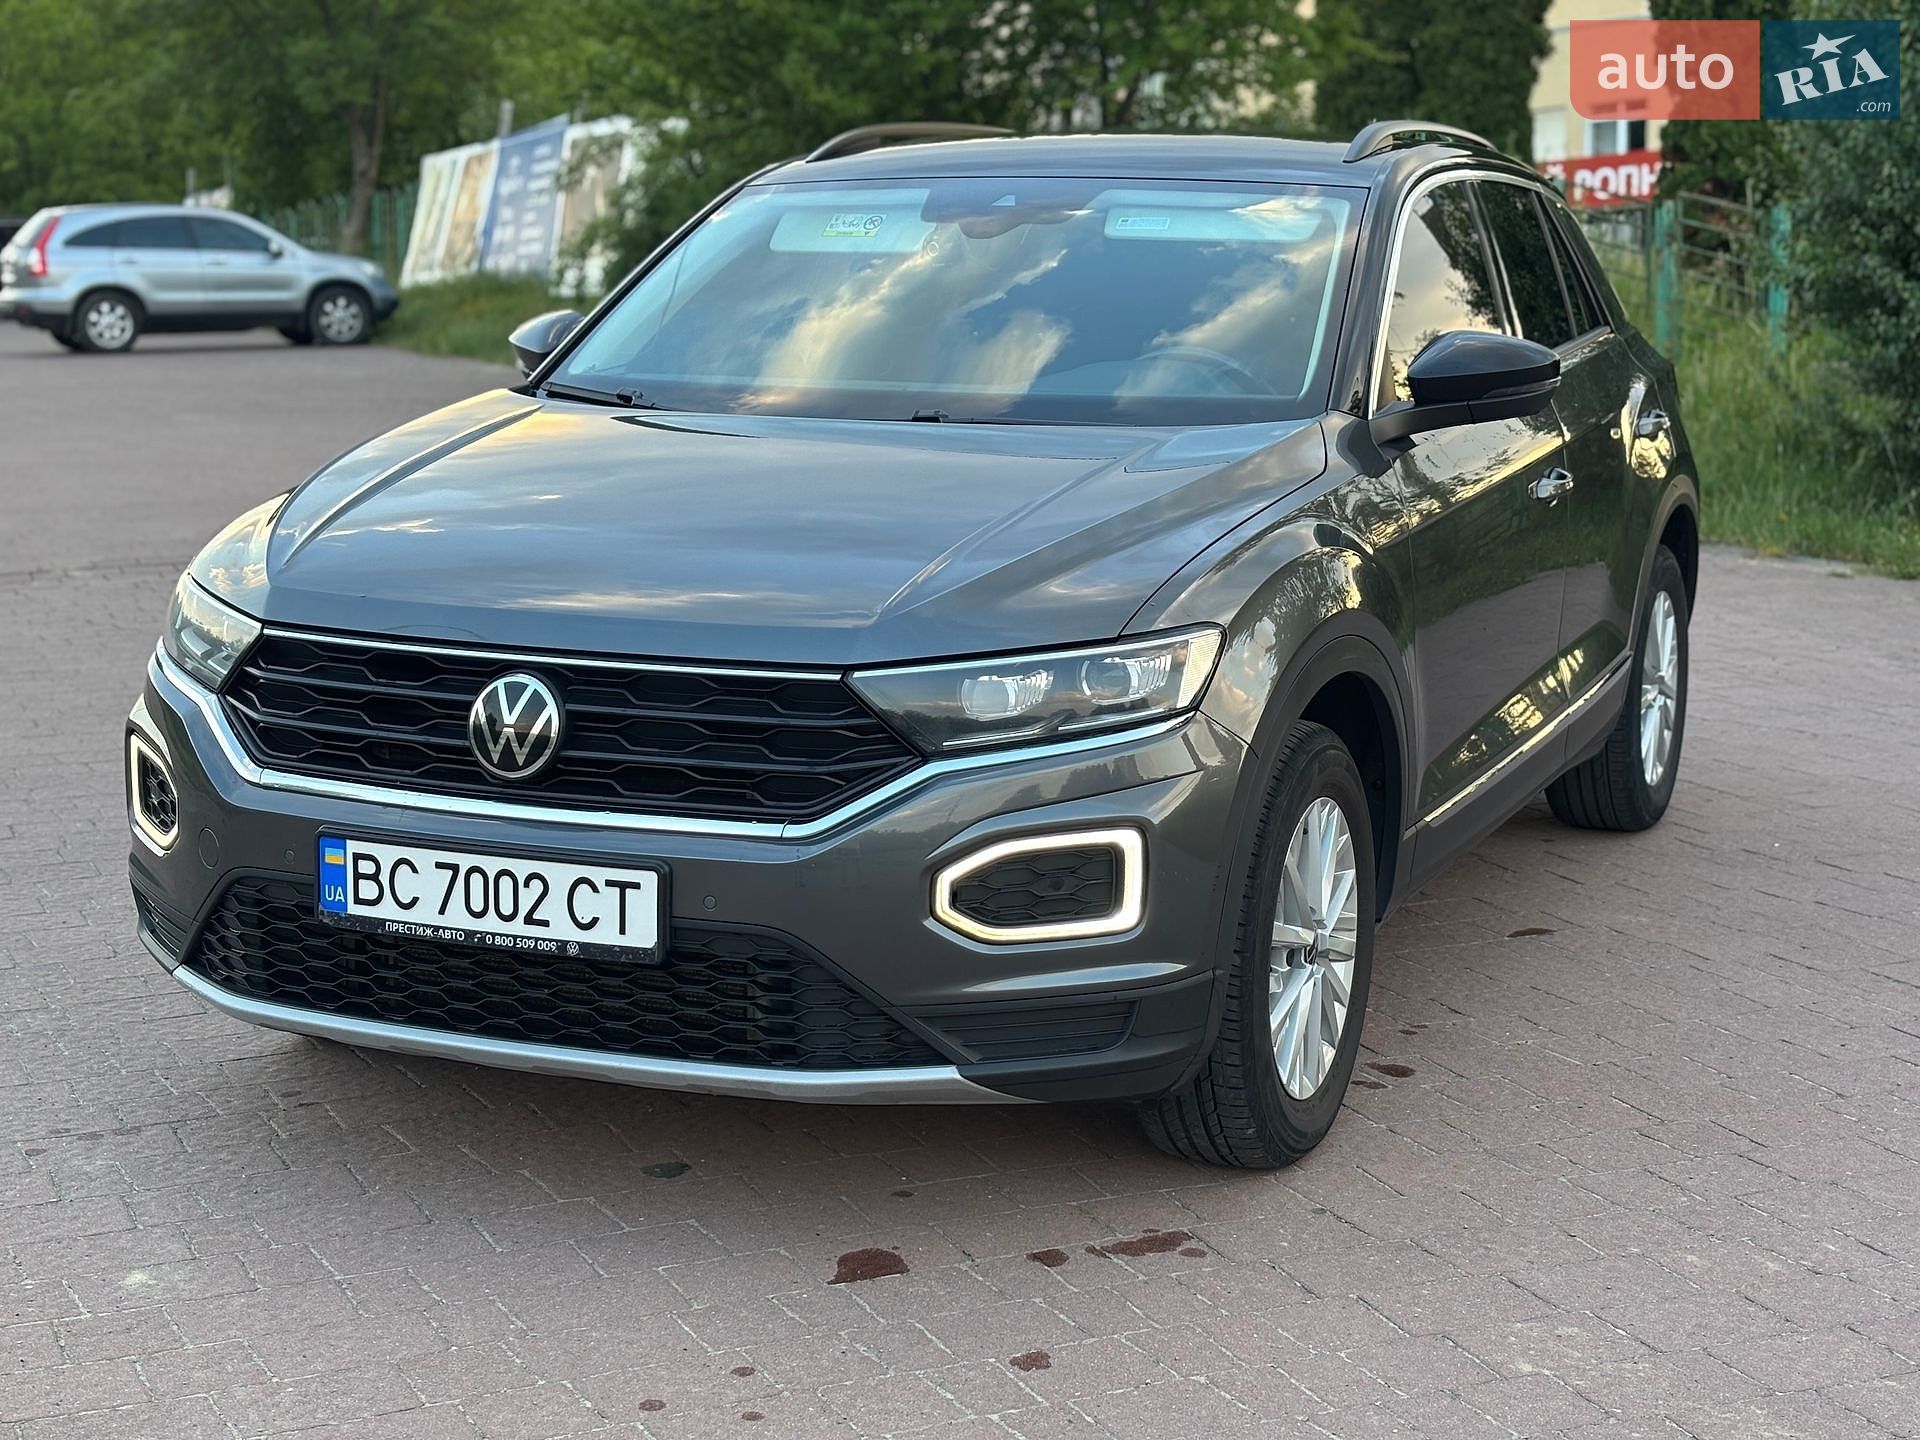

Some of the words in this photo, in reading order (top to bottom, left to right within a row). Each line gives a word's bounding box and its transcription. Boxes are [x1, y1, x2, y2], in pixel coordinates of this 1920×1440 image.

[325, 884, 346, 903] UA
[352, 851, 420, 911] BC
[434, 861, 551, 928] 7002
[566, 876, 641, 936] CT
[385, 921, 465, 941] ПРЕСТИЖ-АВТО
[485, 934, 493, 945] 0
[494, 935, 514, 947] 800
[515, 937, 535, 949] 509
